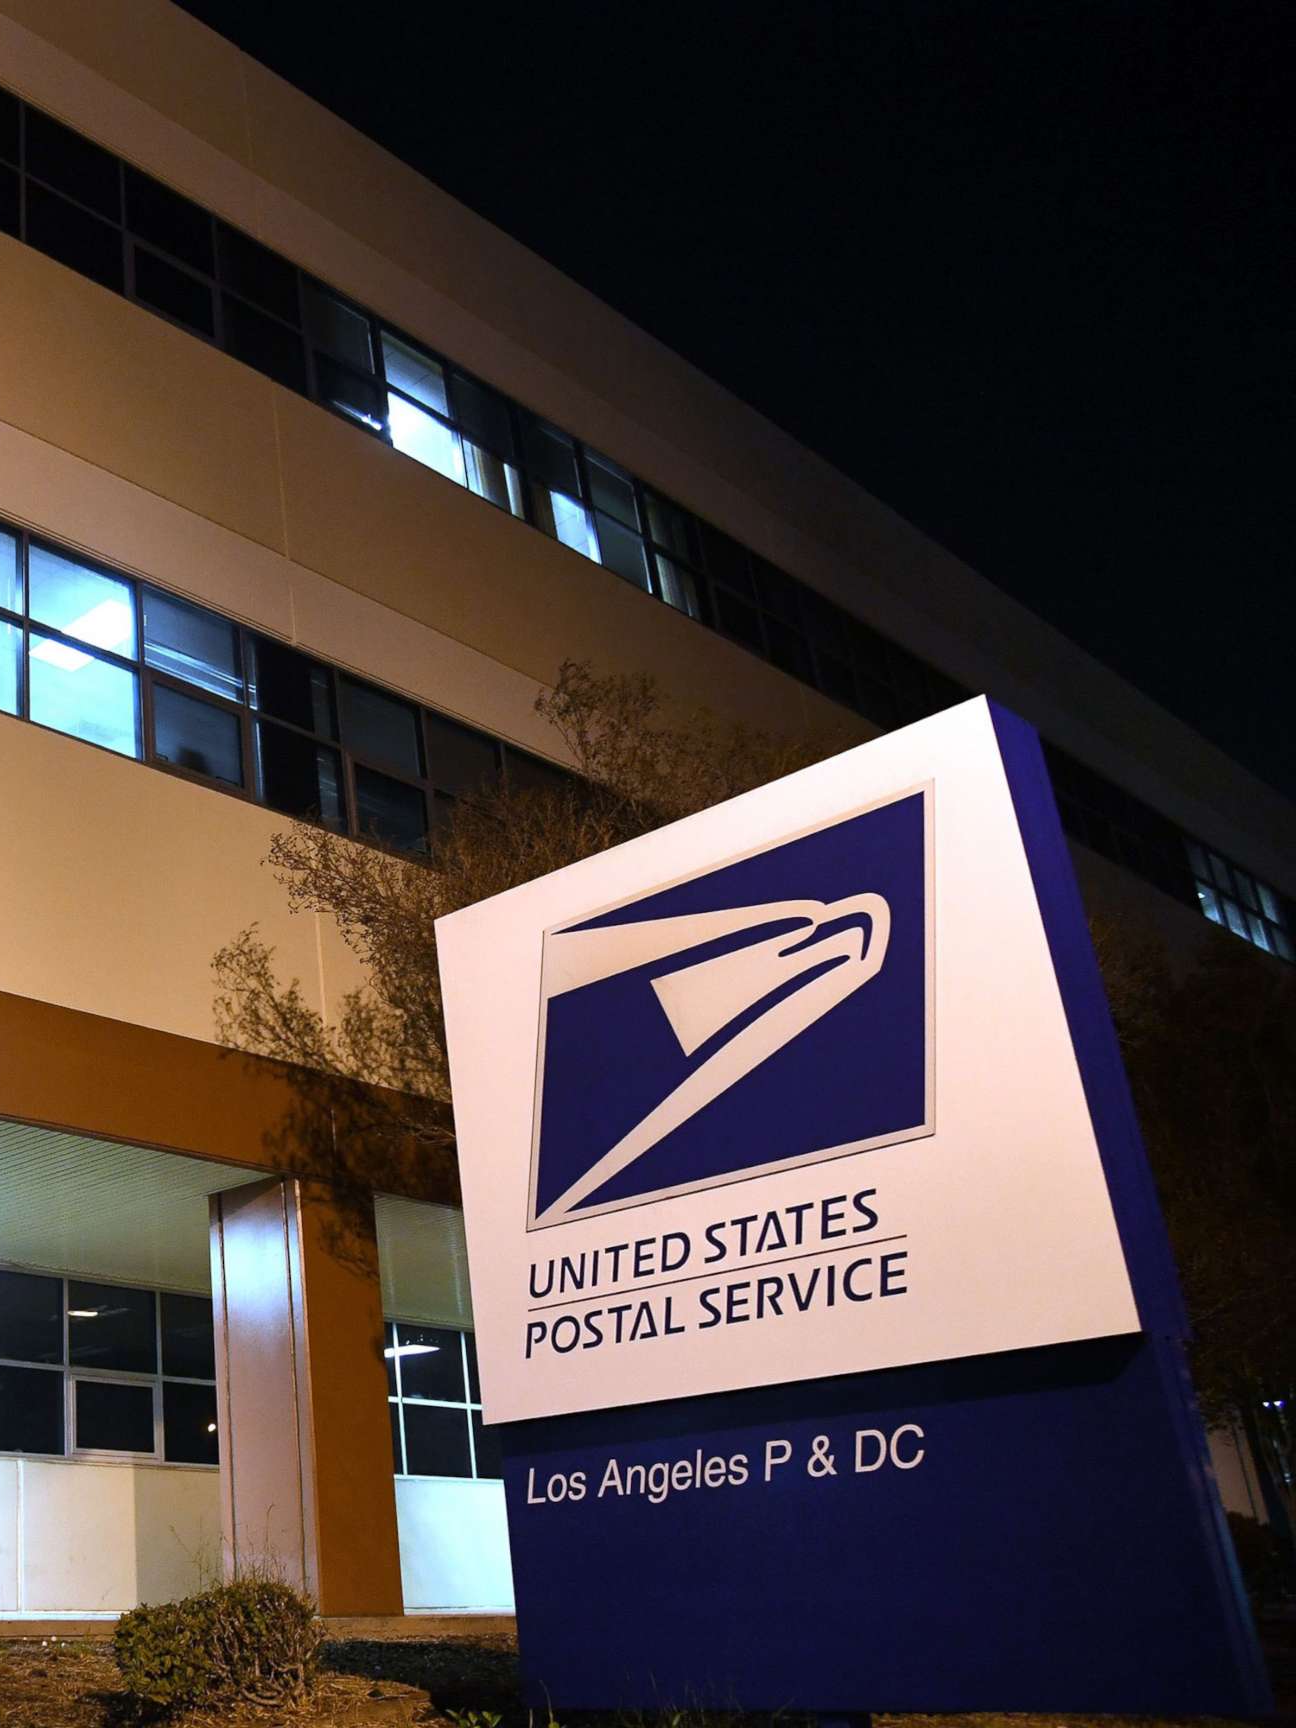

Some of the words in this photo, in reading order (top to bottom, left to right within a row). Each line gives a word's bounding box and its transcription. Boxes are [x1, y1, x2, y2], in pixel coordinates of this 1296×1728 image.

[529, 1231, 692, 1299] UNITED
[704, 1188, 879, 1264] STATES
[525, 1296, 686, 1359] POSTAL
[698, 1251, 909, 1330] SERVICE
[526, 1467, 587, 1504] Los
[597, 1449, 749, 1504] Angeles
[764, 1439, 793, 1482] P
[807, 1434, 838, 1477] &
[854, 1423, 926, 1473] DC
